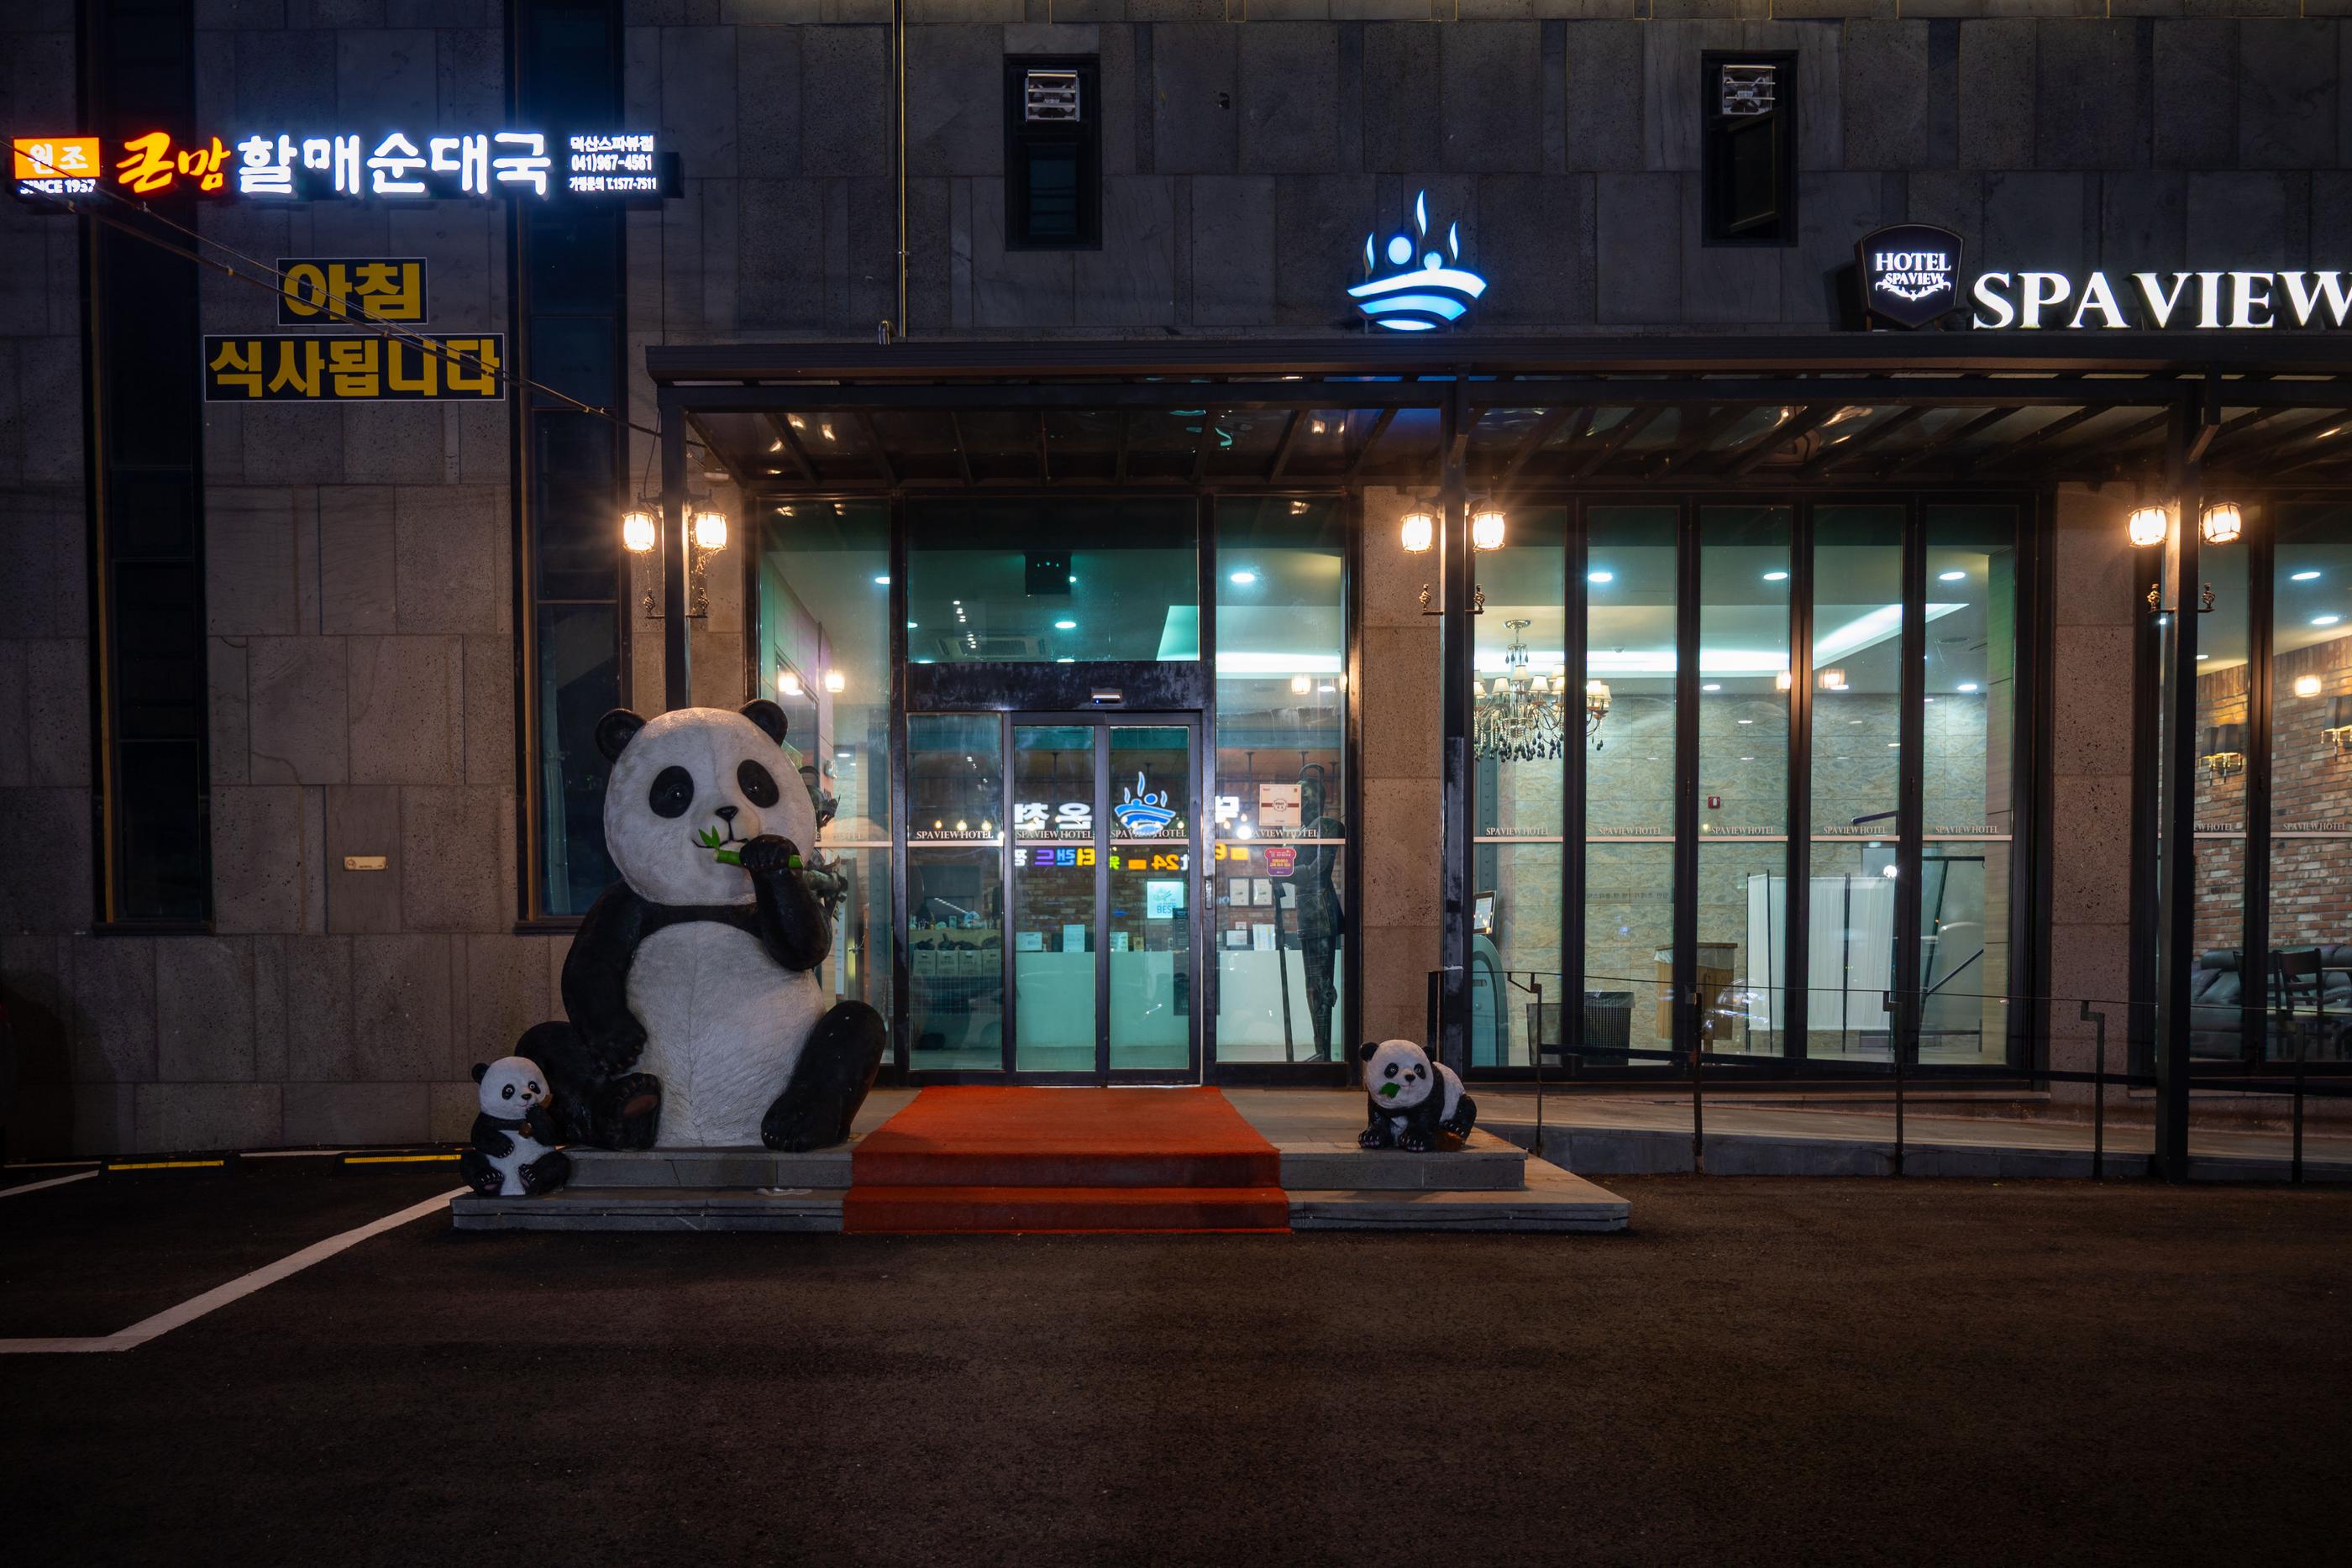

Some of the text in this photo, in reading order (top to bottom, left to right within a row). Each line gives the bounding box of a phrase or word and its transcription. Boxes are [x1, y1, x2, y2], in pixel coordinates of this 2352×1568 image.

[28, 143, 89, 175] 원조
[116, 132, 552, 195] 큰맘 할매순대국
[1875, 252, 1952, 271] HOTEL
[1885, 272, 1945, 286] SPAVIEW
[283, 263, 421, 320] 아침
[209, 338, 500, 397] 식사됩니다
[1486, 826, 1520, 836] SPAVIEW
[1599, 826, 1662, 835] SPAVIEW HOTEL
[1711, 826, 1774, 835] SPAVIEW HOTEL
[1823, 826, 1886, 834] SPAVIEW HOTEL
[1935, 826, 1999, 834] SPAVIEW HOTEL
[2208, 823, 2233, 831] HOTEL
[2283, 822, 2346, 831] SPAVIEW HOTEL
[916, 830, 993, 840] SPAVIEW HOTEL
[1017, 830, 1092, 839] SPAVIEW HOTEL
